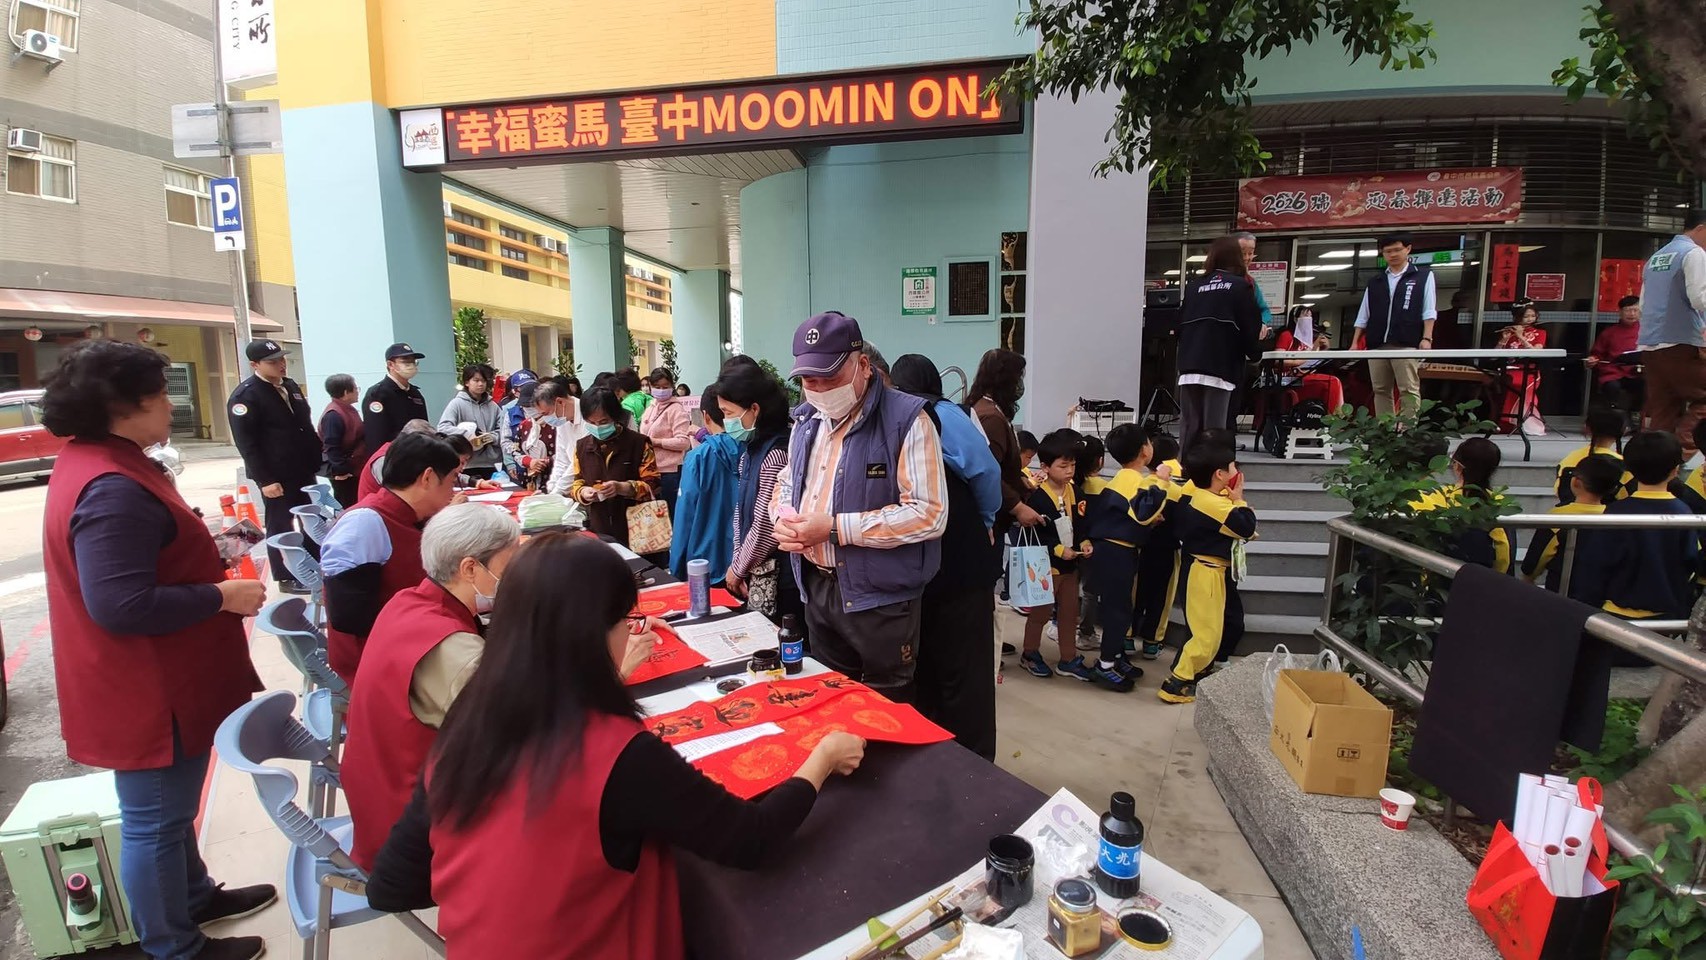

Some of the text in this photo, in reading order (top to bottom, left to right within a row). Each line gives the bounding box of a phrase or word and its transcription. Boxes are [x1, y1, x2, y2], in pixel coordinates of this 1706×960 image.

[456, 101, 609, 154] 幸福蜜馬
[619, 82, 895, 144] 臺中MOOMIN
[214, 184, 237, 227] P
